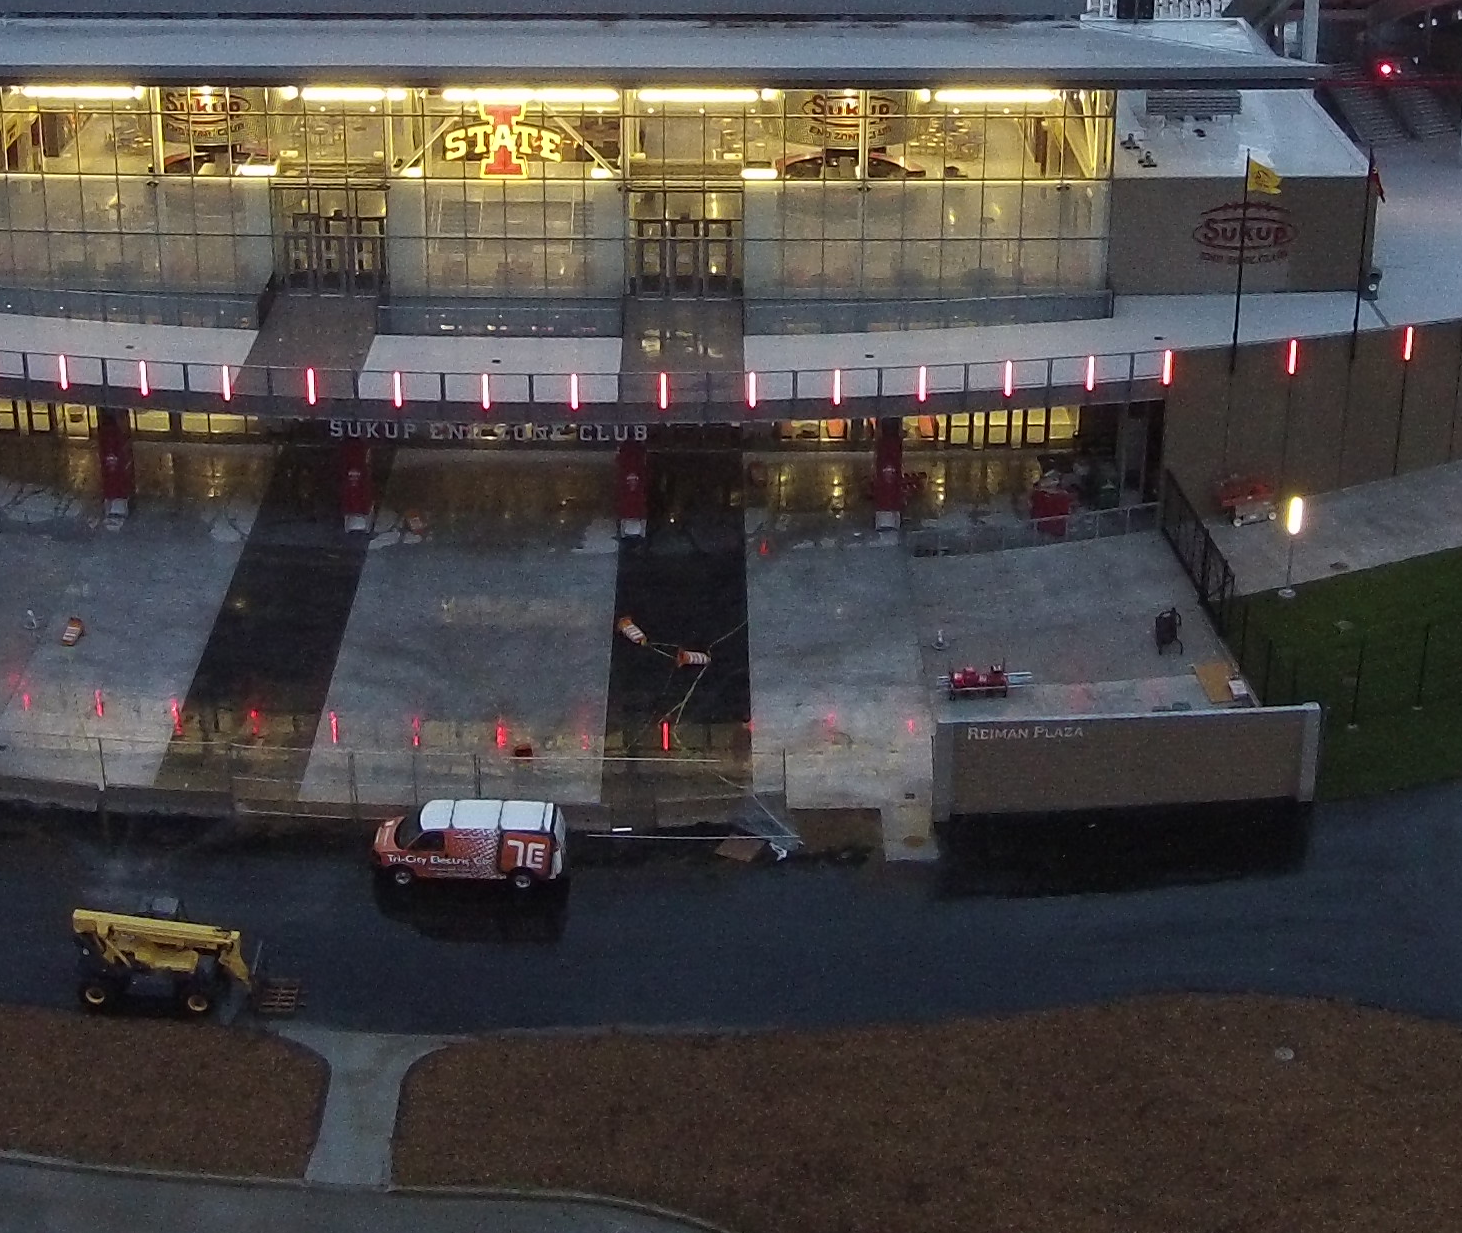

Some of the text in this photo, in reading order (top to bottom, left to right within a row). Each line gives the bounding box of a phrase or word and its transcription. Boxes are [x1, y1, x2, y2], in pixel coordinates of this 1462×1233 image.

[444, 124, 563, 163] STATE
[329, 420, 417, 438] SUKUP
[579, 424, 649, 442] CLUB
[967, 725, 1084, 741] REIMAN PLAZA
